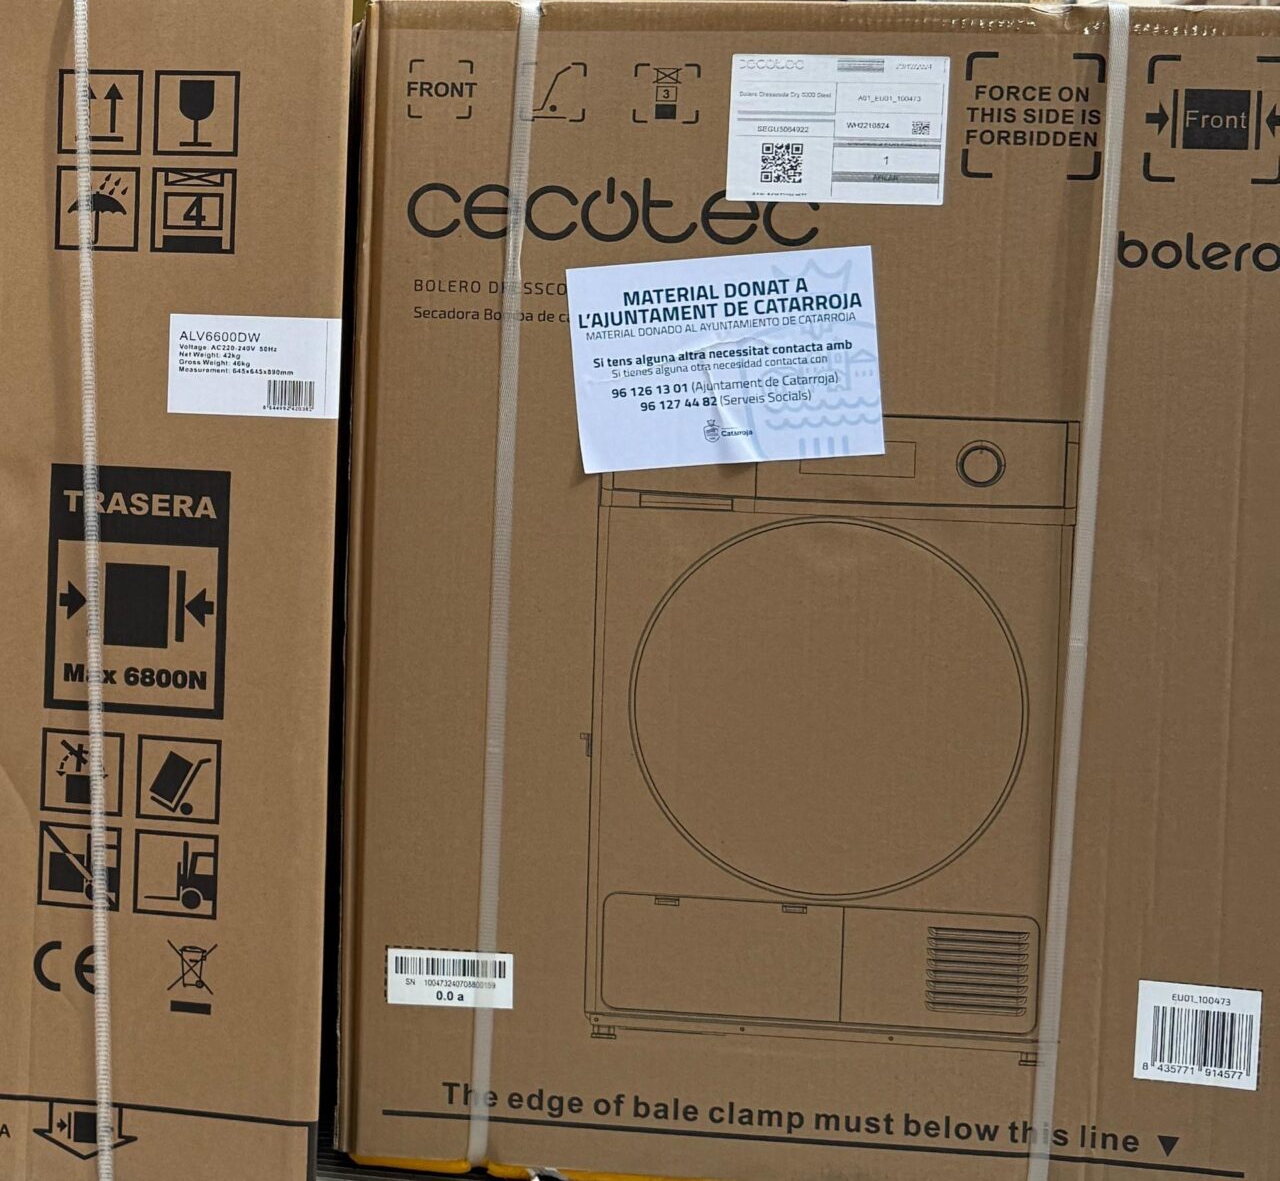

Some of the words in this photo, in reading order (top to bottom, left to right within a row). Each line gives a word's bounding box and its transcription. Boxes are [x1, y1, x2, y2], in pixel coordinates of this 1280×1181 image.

[406, 81, 478, 98] FRONT
[662, 88, 671, 99] 3
[975, 85, 1051, 102] FORCE
[1058, 86, 1089, 102] ON
[967, 107, 1017, 123] THIS
[1023, 108, 1074, 125] SIDE
[1081, 109, 1101, 125] IS
[1185, 110, 1247, 130] Front
[966, 130, 1097, 147] FORBIDDEN
[182, 193, 206, 228] 4
[407, 177, 820, 247] cecotec
[1117, 230, 1280, 272] bolero
[414, 279, 481, 294] BOLERO
[488, 280, 567, 296] DSSCO
[623, 284, 720, 307] MATERIAL
[724, 278, 790, 298] DONAT
[796, 277, 808, 293] A
[413, 306, 480, 320] Secadora
[484, 308, 533, 322] Boba
[537, 310, 555, 323] de
[578, 303, 718, 329] L'AJUNTAMENT
[724, 301, 749, 317] DE
[754, 292, 862, 315] CATARROJA
[179, 331, 261, 343] ALV6600DW
[586, 327, 636, 341] MATERIAL
[638, 324, 682, 337] DONADO
[685, 323, 698, 333] AL
[699, 317, 780, 332] AYUNTAMIENTO
[782, 315, 796, 326] DE
[798, 312, 856, 325] CATARROJA
[593, 357, 604, 368] Si
[606, 355, 633, 367] tens
[635, 353, 676, 368] alguna
[678, 349, 706, 362] altra
[708, 345, 770, 359] necessitat
[772, 341, 823, 355] contacta
[826, 339, 853, 351] amb
[611, 369, 621, 379] Si
[623, 366, 653, 378] tienes
[655, 364, 688, 378] alguna
[690, 363, 711, 373] otra
[713, 358, 762, 371] necesidad
[764, 354, 809, 367] contacta
[810, 356, 828, 365] con
[612, 387, 627, 399] 96
[630, 385, 653, 398] 126
[656, 384, 670, 396] 13
[673, 383, 688, 394] 01
[691, 377, 763, 395] (Ajuntament
[765, 376, 779, 388] de
[782, 370, 839, 388] Catarroja)
[640, 401, 656, 412] 96
[659, 399, 681, 410] 127
[684, 397, 699, 408] 44
[702, 396, 717, 407] 82
[719, 393, 765, 408] (Serveis
[768, 390, 812, 404] Socials)
[64, 663, 117, 684] Mx
[124, 667, 207, 691] 6800N
[436, 991, 454, 1001] 0.0
[457, 993, 464, 1001] a
[1172, 993, 1231, 1006] EU01_100473
[1142, 1062, 1148, 1070] 8
[1157, 1063, 1194, 1075] 435771
[1205, 1068, 1243, 1080] 914577
[442, 1082, 499, 1108] The
[507, 1088, 584, 1117] edge
[593, 1094, 626, 1117] of
[633, 1095, 699, 1123] bale
[708, 1101, 804, 1134] clamp
[814, 1111, 894, 1135] must
[904, 1113, 1000, 1142] below
[1080, 1124, 1140, 1153] line
